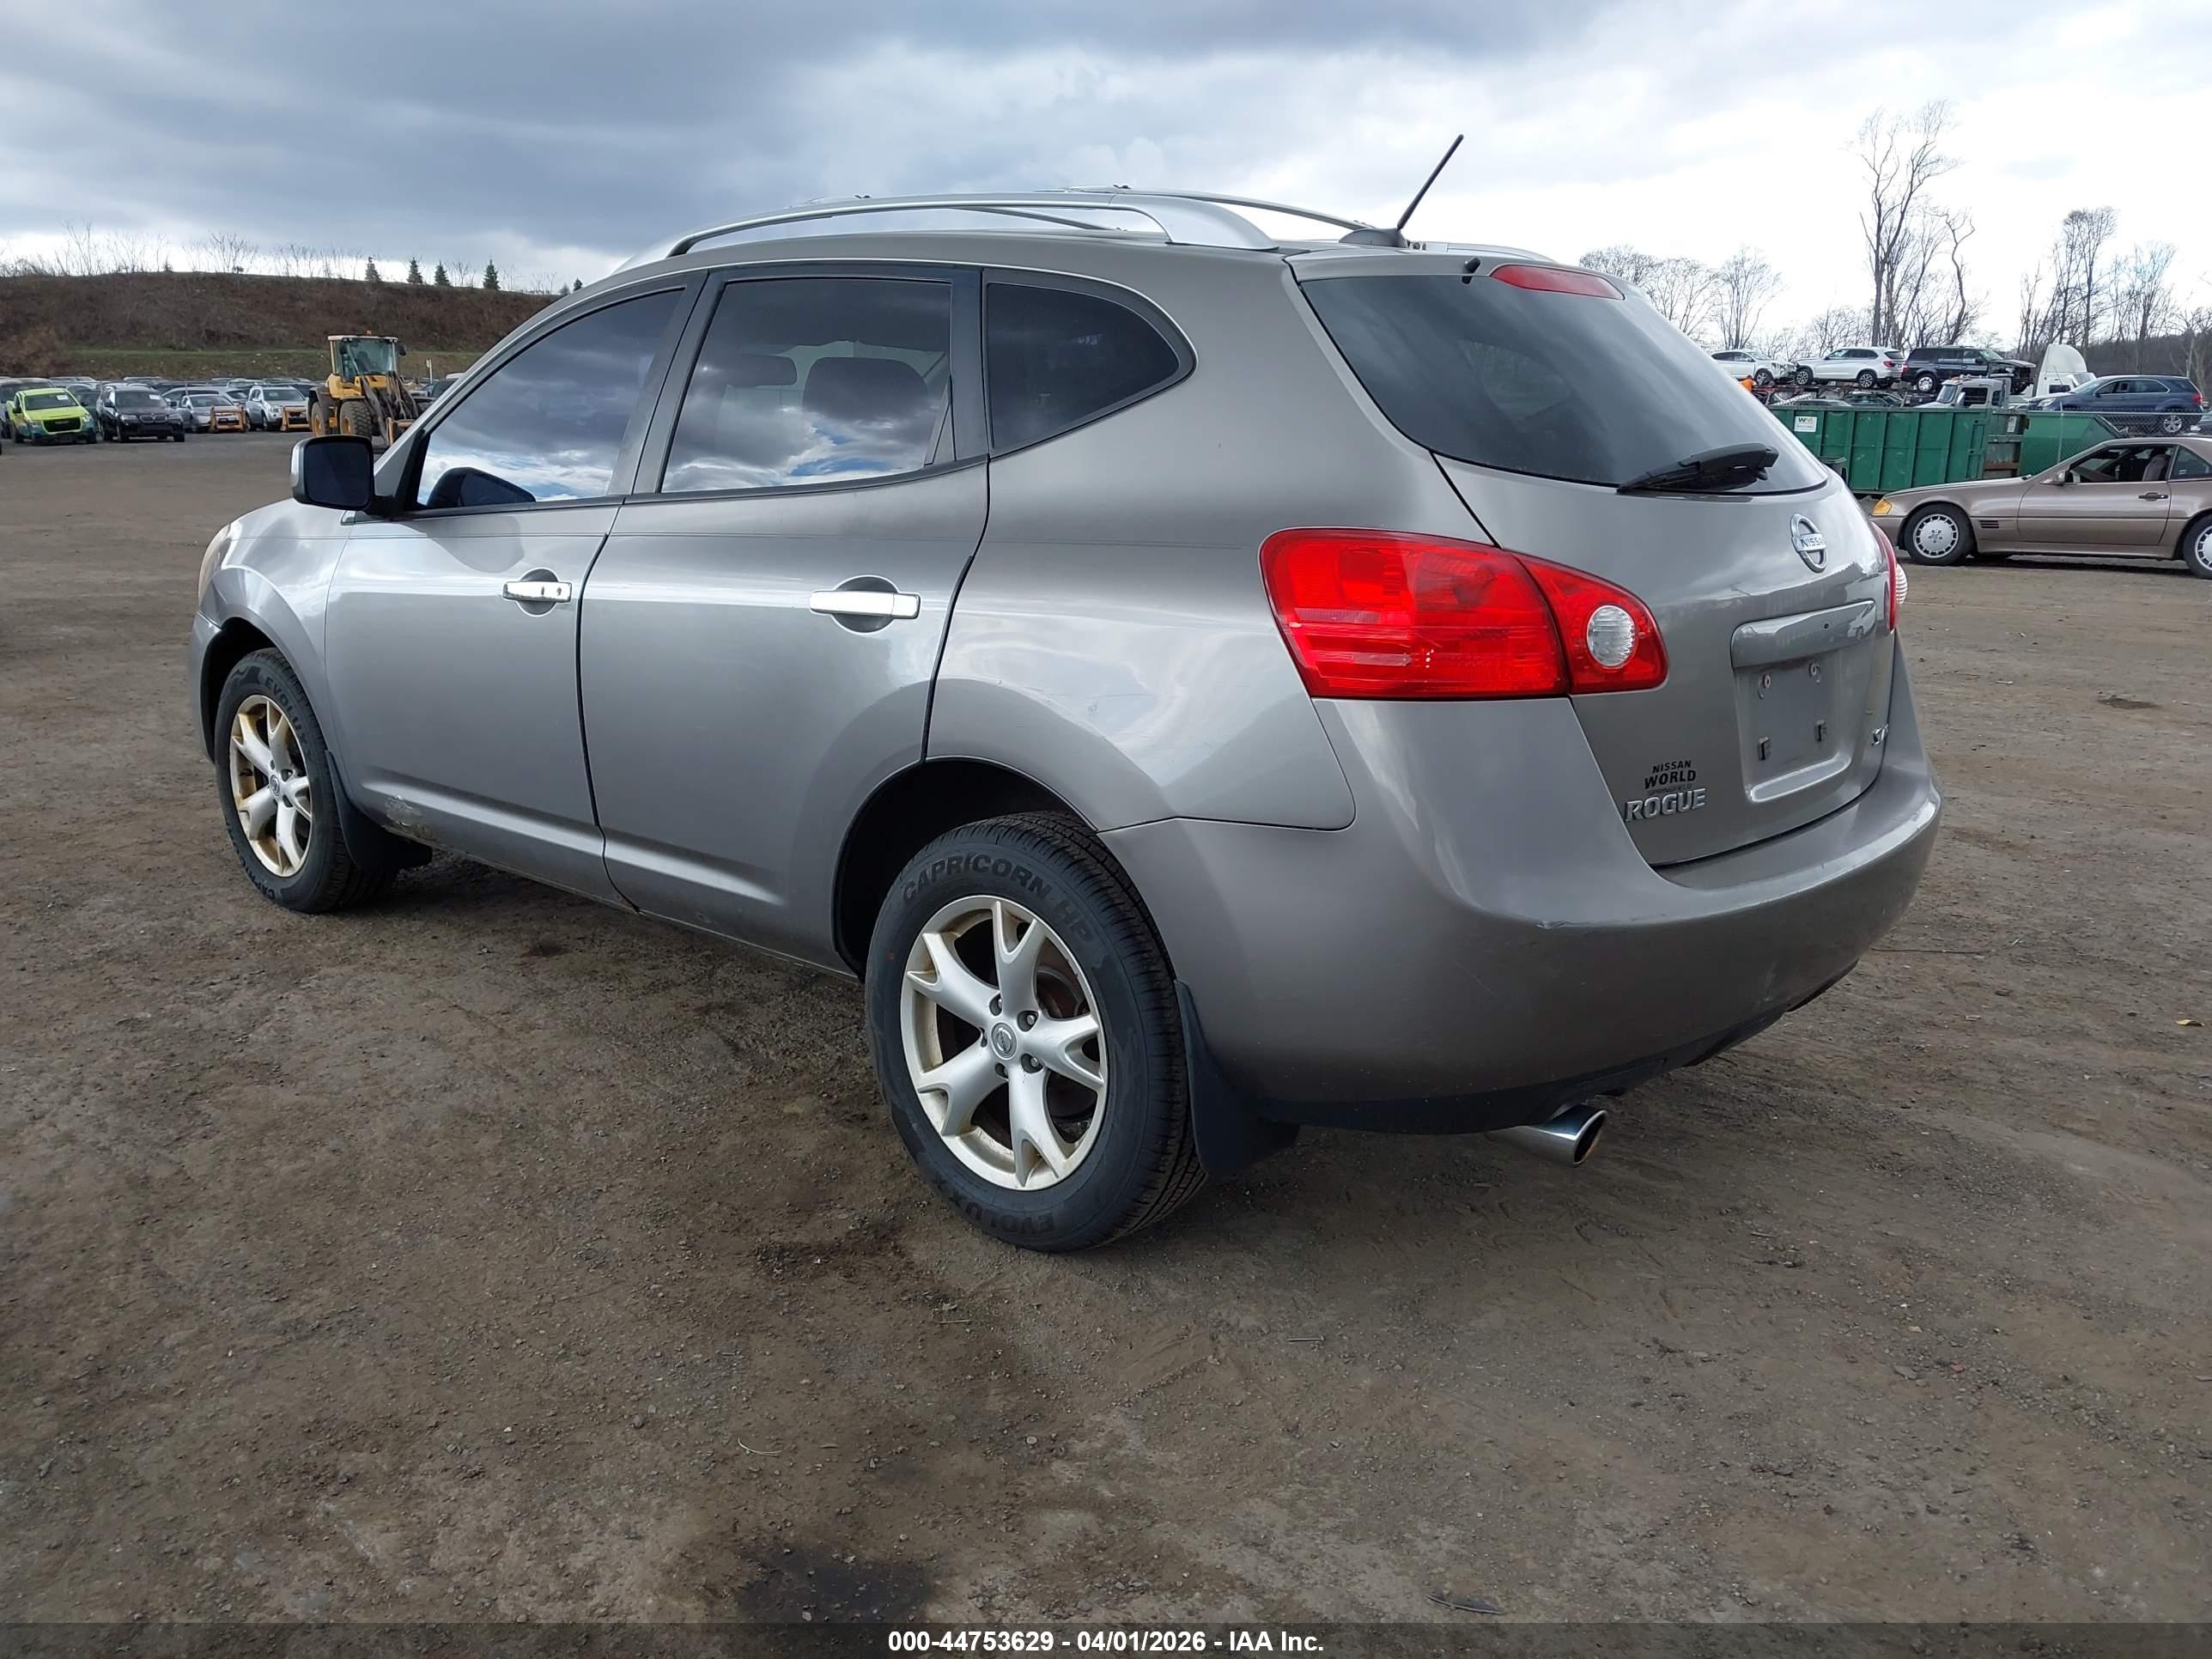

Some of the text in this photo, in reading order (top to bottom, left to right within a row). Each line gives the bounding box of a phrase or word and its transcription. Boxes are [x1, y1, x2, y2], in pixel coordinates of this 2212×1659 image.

[1644, 769, 1697, 789] WORLD
[1652, 760, 1692, 774] NISSAN
[1624, 787, 1706, 823] ROGUE
[902, 852, 1053, 902] CAPRICORN
